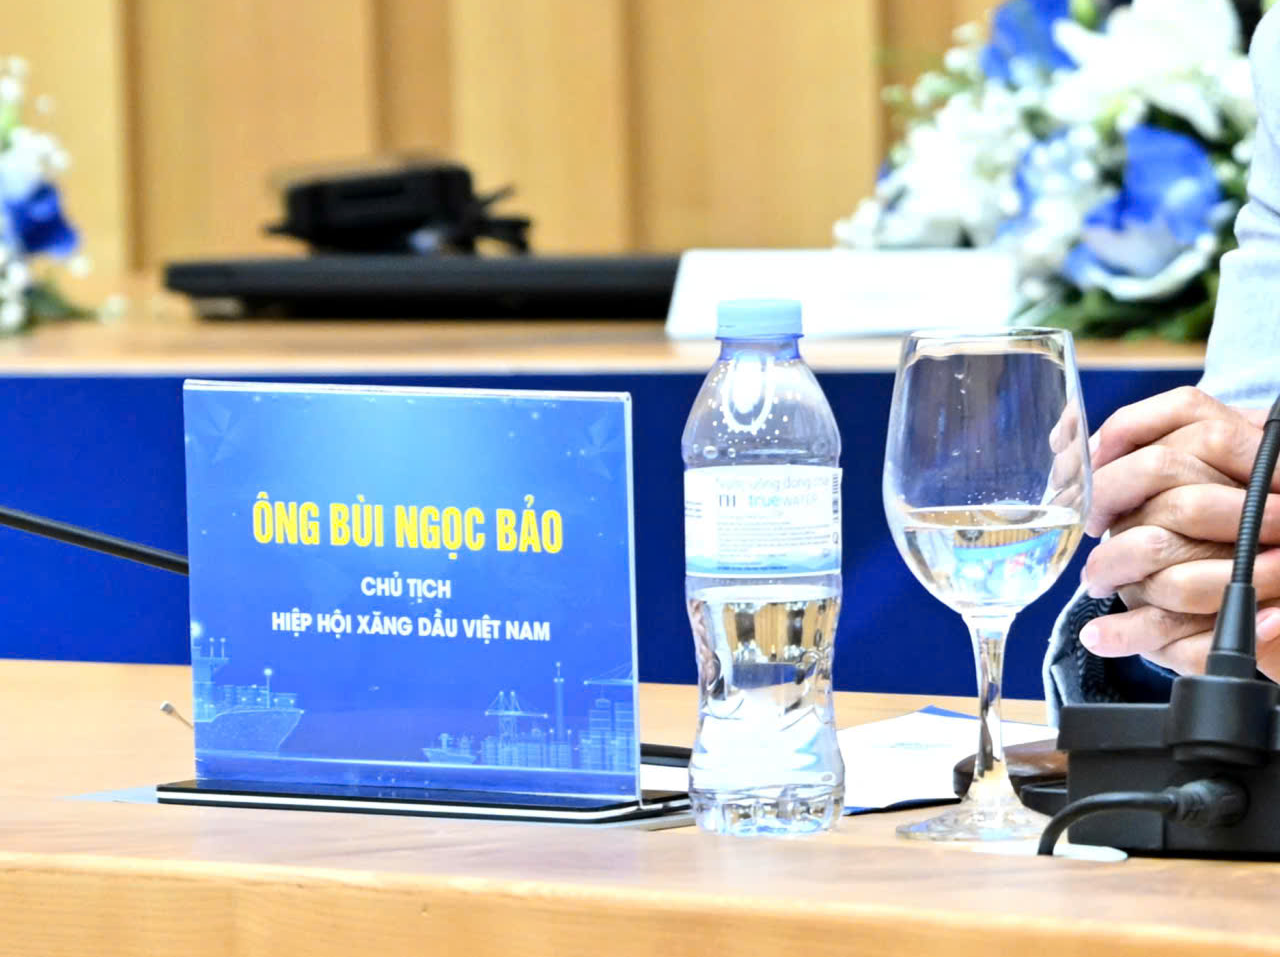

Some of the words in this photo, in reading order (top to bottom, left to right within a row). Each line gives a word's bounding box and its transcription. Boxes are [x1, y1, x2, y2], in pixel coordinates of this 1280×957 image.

[747, 494, 783, 508] true
[253, 491, 321, 545] ÔNG
[329, 494, 385, 548] BÙI
[395, 504, 486, 560] NGỌC
[495, 494, 563, 554] BẢO
[360, 571, 403, 597] CHỦ
[406, 578, 451, 603] TỊCH
[271, 607, 313, 637] HIỆP
[317, 608, 352, 639] HỘI
[356, 611, 413, 637] XĂNG
[417, 608, 458, 638] DẦU
[462, 614, 501, 645] VIỆT
[505, 620, 551, 641] NAM
